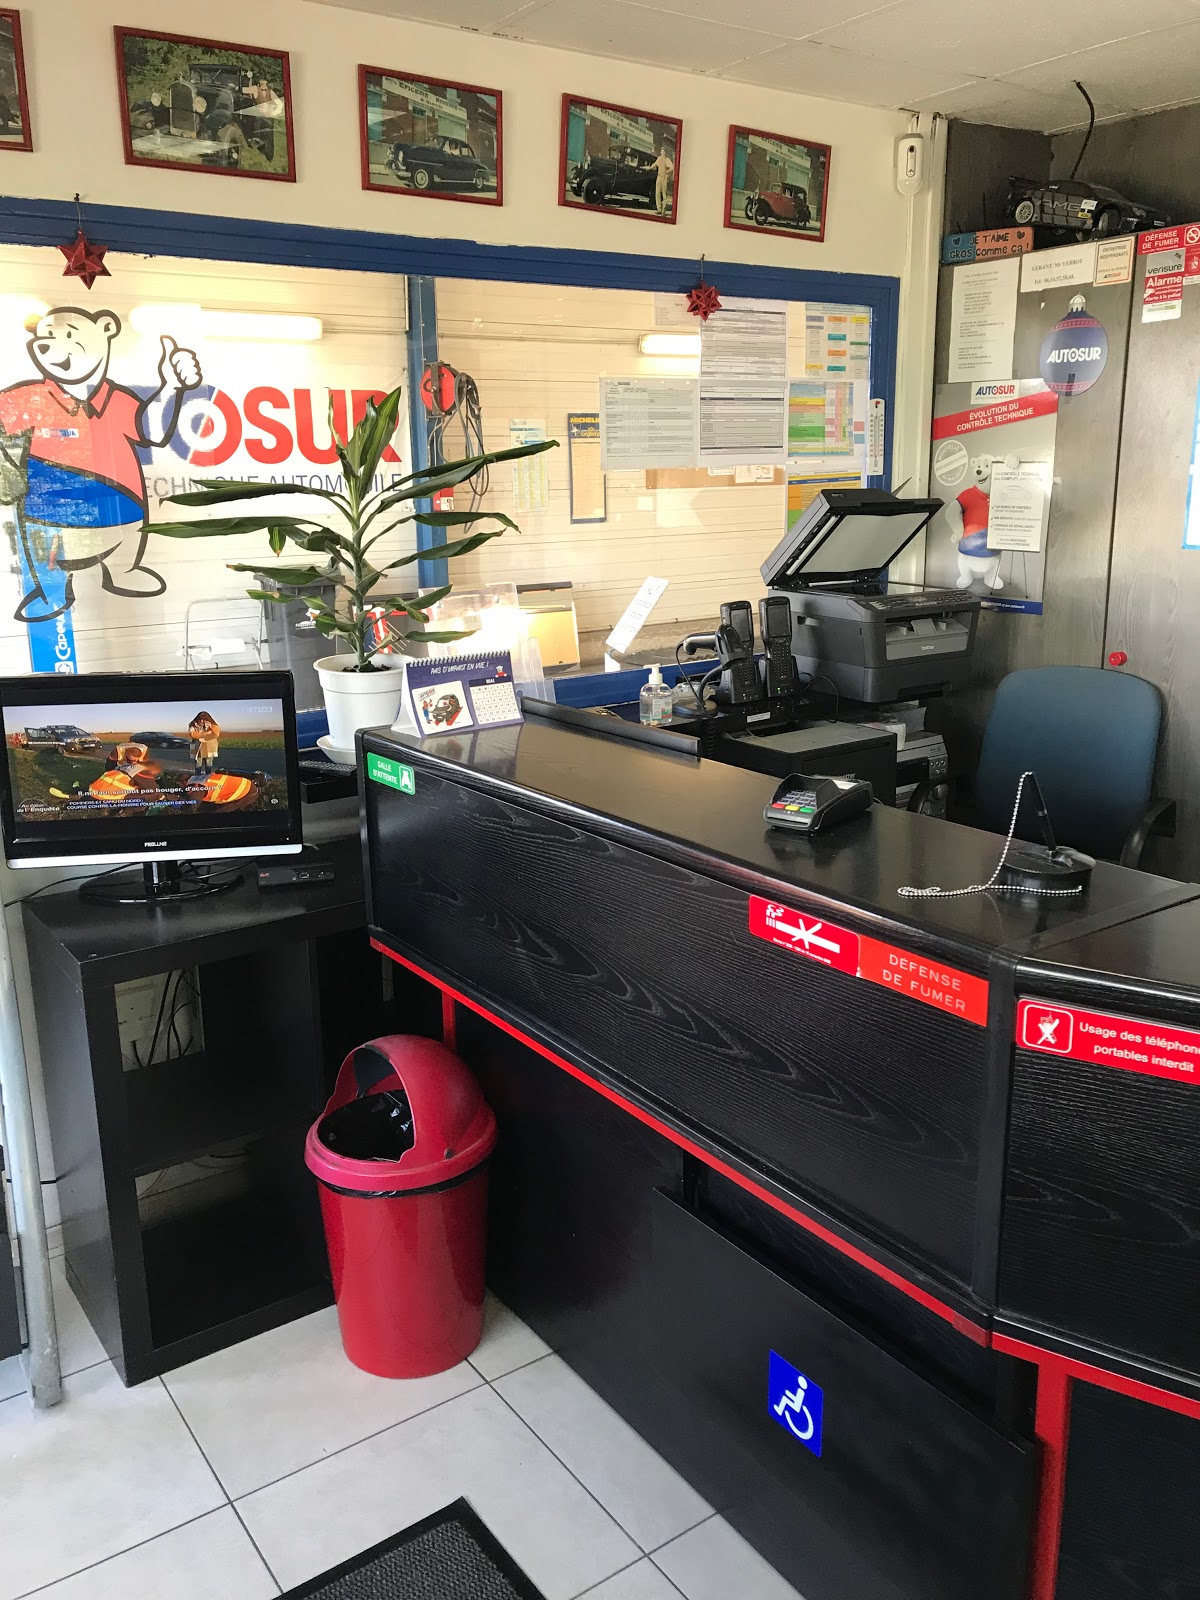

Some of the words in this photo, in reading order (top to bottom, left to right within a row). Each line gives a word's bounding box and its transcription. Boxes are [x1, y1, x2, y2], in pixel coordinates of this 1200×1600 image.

[970, 236, 980, 245] JE
[1145, 230, 1178, 242] DÉFENSE
[1154, 237, 1180, 248] FUMER
[949, 248, 973, 260] GROS
[975, 245, 1008, 257] comme
[1147, 263, 1183, 275] verisure
[1146, 275, 1183, 288] Alarme
[1046, 347, 1102, 363] AUTOSUR
[975, 384, 1016, 396] AUTOSUR
[969, 405, 1008, 421] ÉVOLUTION
[1008, 402, 1019, 411] DU
[956, 418, 993, 432] CONTRÔLE
[994, 407, 1034, 423] TECHNIQUE
[467, 663, 474, 671] EN
[377, 760, 392, 773] SALLE
[372, 768, 398, 785] D'ATTENTE
[155, 786, 184, 794] bouger,
[889, 953, 962, 991] DÉFENSE
[882, 969, 903, 986] DE
[910, 980, 966, 1012] FUMER
[1079, 1021, 1117, 1039] Usage
[1120, 1031, 1142, 1043] des
[1093, 1045, 1149, 1063] portables
[1151, 1055, 1195, 1073] interdit
